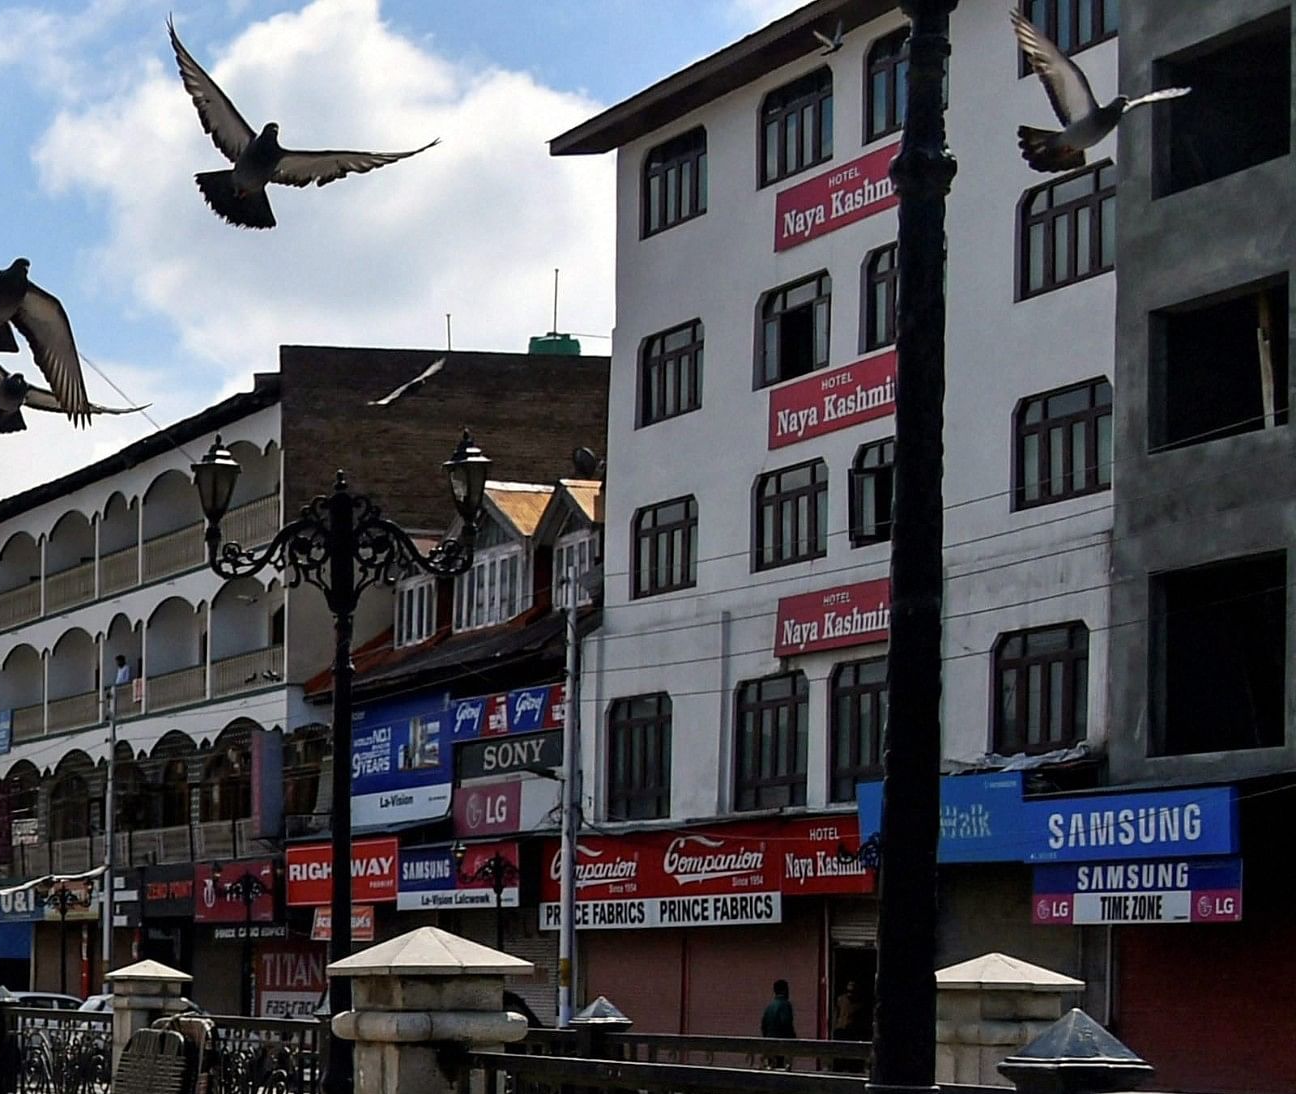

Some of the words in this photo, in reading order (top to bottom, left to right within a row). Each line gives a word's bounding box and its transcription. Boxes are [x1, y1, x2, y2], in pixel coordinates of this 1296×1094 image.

[828, 167, 861, 188] HOTEL
[782, 204, 825, 238] Naya
[830, 175, 896, 220] Kashm
[821, 372, 854, 390] HOTEL
[776, 406, 818, 437] Naya
[823, 591, 851, 606] HOTEL
[782, 618, 818, 650] Naya
[352, 753, 361, 778] 9
[361, 756, 390, 774] YEARS
[483, 738, 546, 771] SONY
[379, 793, 414, 809] La-Vision
[485, 795, 507, 824] LG
[809, 827, 840, 841] HOTEL
[1048, 803, 1201, 850] SAMSUNG
[289, 863, 333, 882] RIGH
[351, 856, 394, 877] WAY
[402, 859, 451, 880] SAMSUNG
[663, 835, 764, 880] Companion
[785, 852, 814, 886] Naya
[1077, 862, 1189, 890] SAMSUNG
[421, 894, 453, 906] La-Vision
[660, 898, 709, 923] PRINCE
[713, 895, 773, 920] FABRICS
[1052, 900, 1069, 917] LG
[1100, 896, 1131, 921] TIME
[1132, 895, 1163, 921] ZONE
[1215, 897, 1234, 915] LG
[546, 902, 589, 926] PRCE
[593, 901, 645, 925] FABRICS
[261, 953, 323, 987] TITAN
